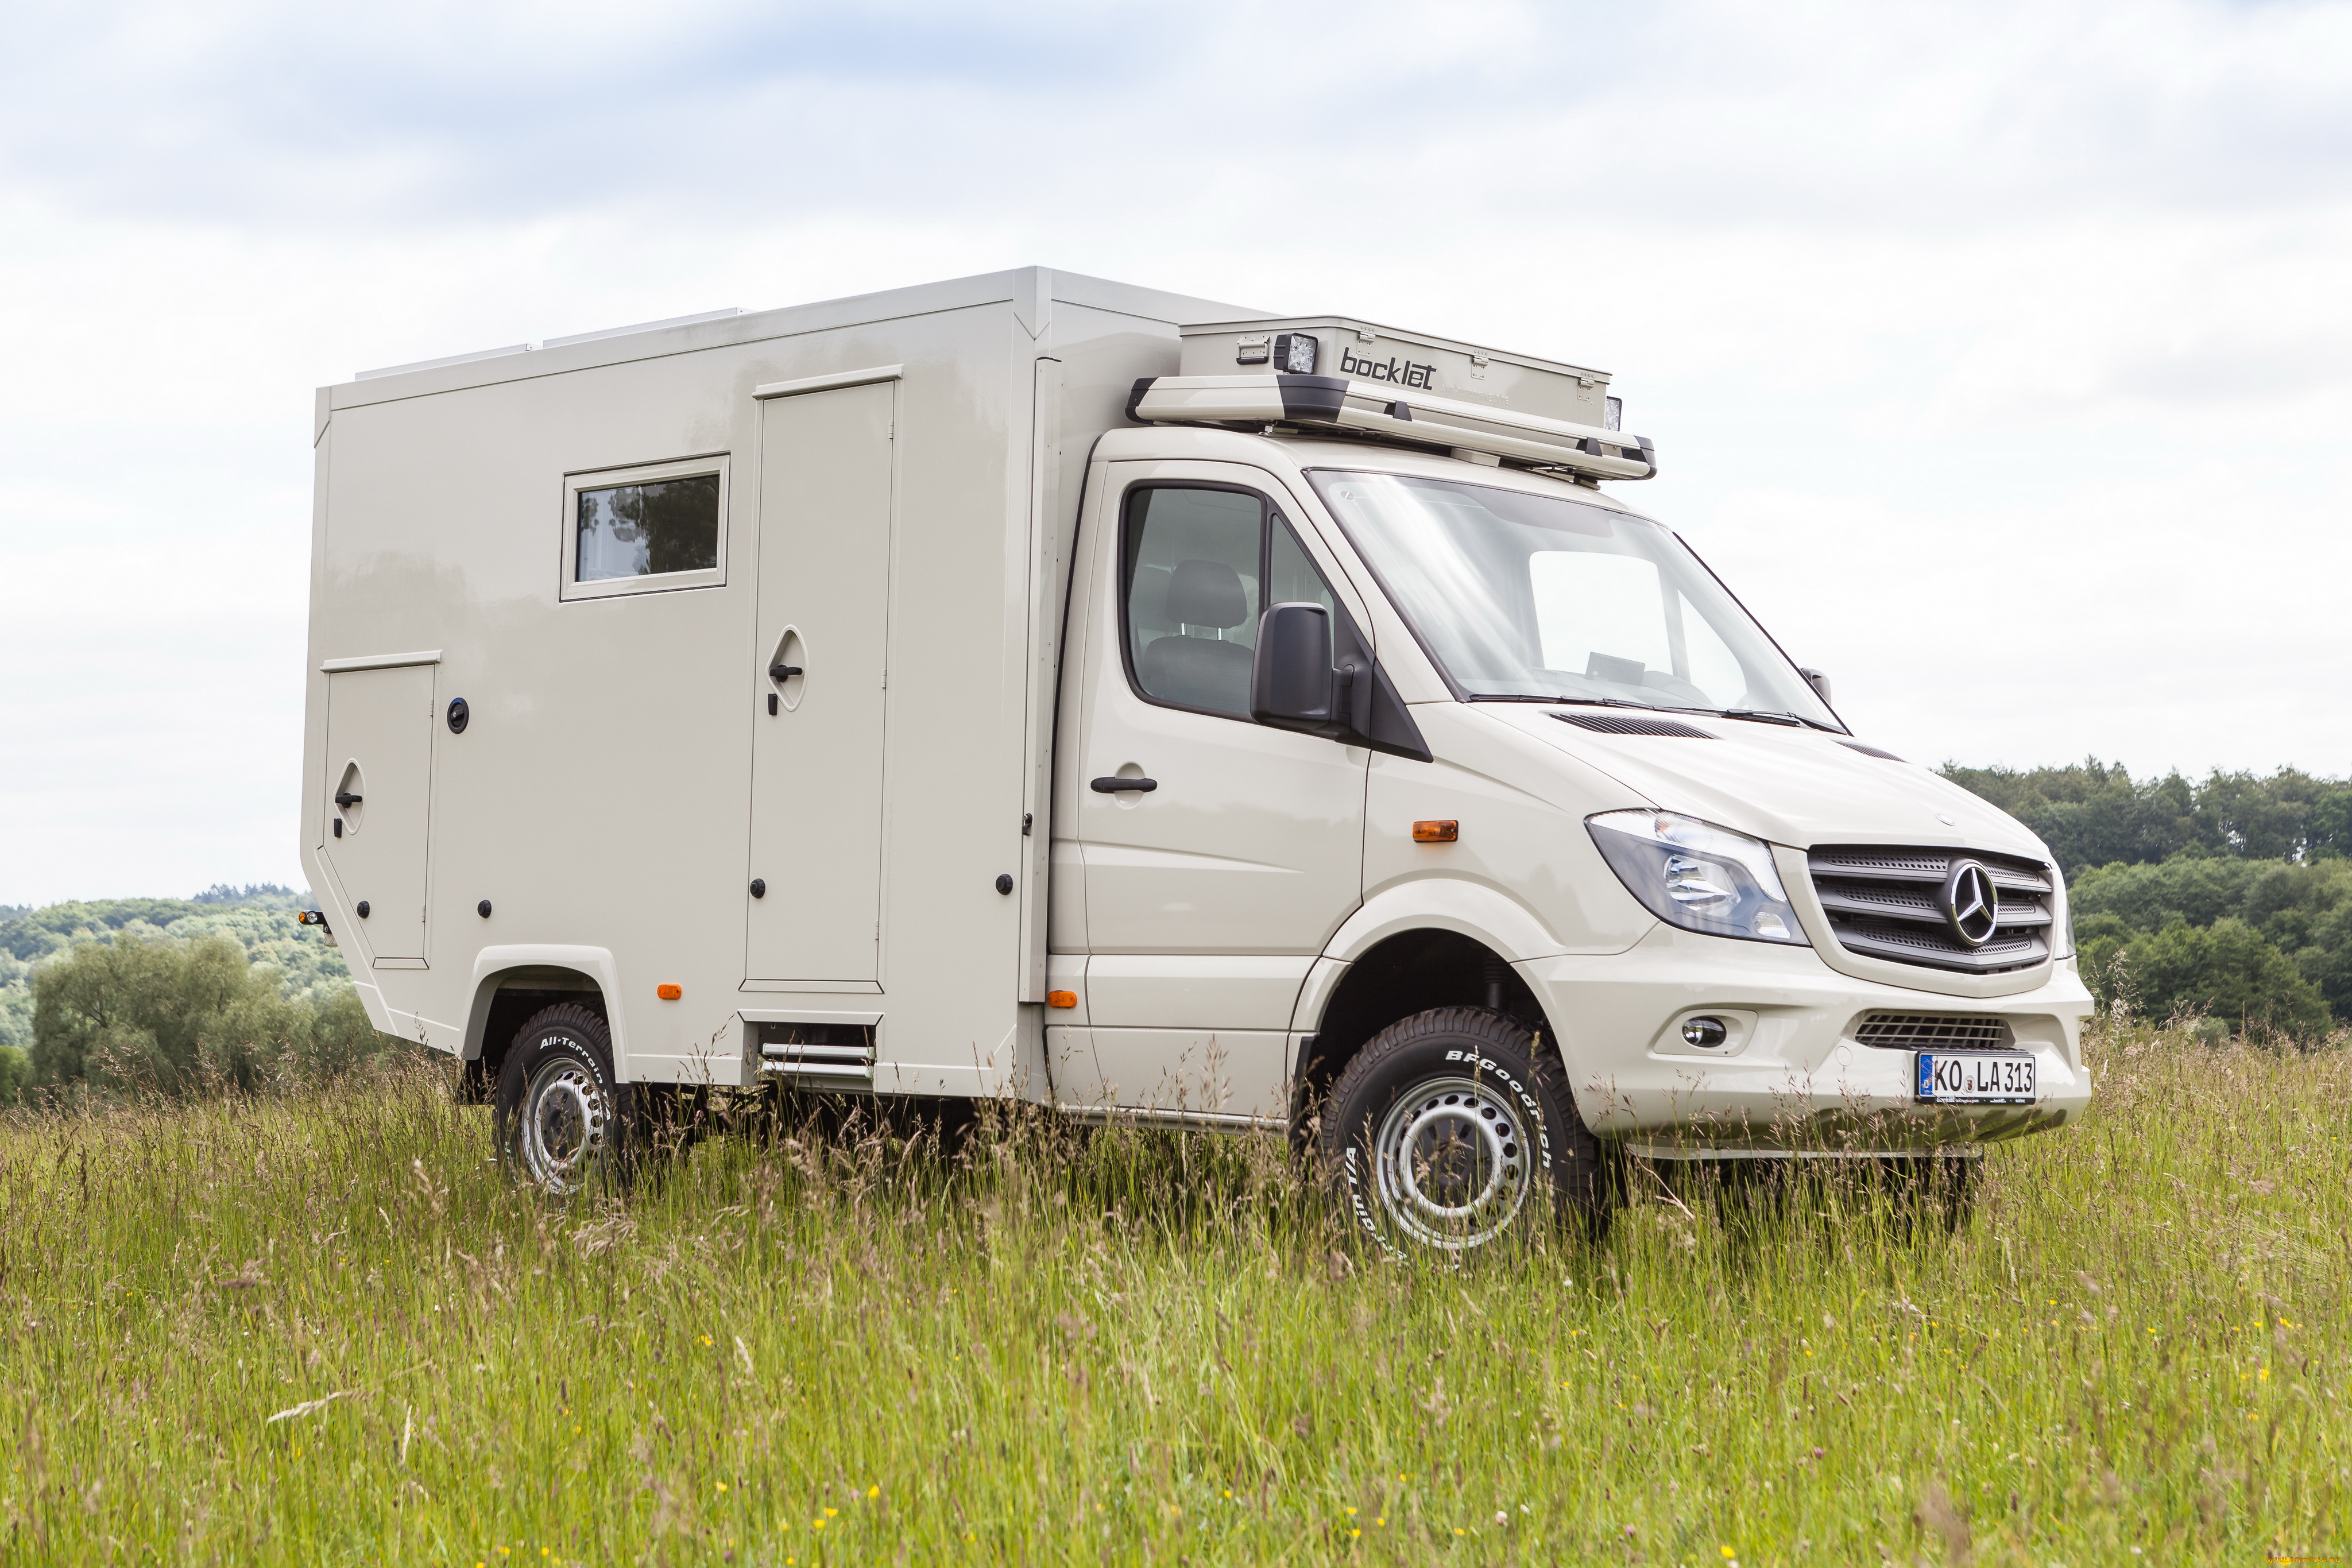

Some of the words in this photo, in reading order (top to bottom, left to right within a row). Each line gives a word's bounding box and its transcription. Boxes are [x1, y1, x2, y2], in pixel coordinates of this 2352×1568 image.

[540, 1036, 603, 1084] All-Terrain
[1935, 1060, 1962, 1091] KO
[1978, 1061, 2000, 1091] LA
[2005, 1062, 2032, 1092] 313
[1345, 1147, 1357, 1186] T/A
